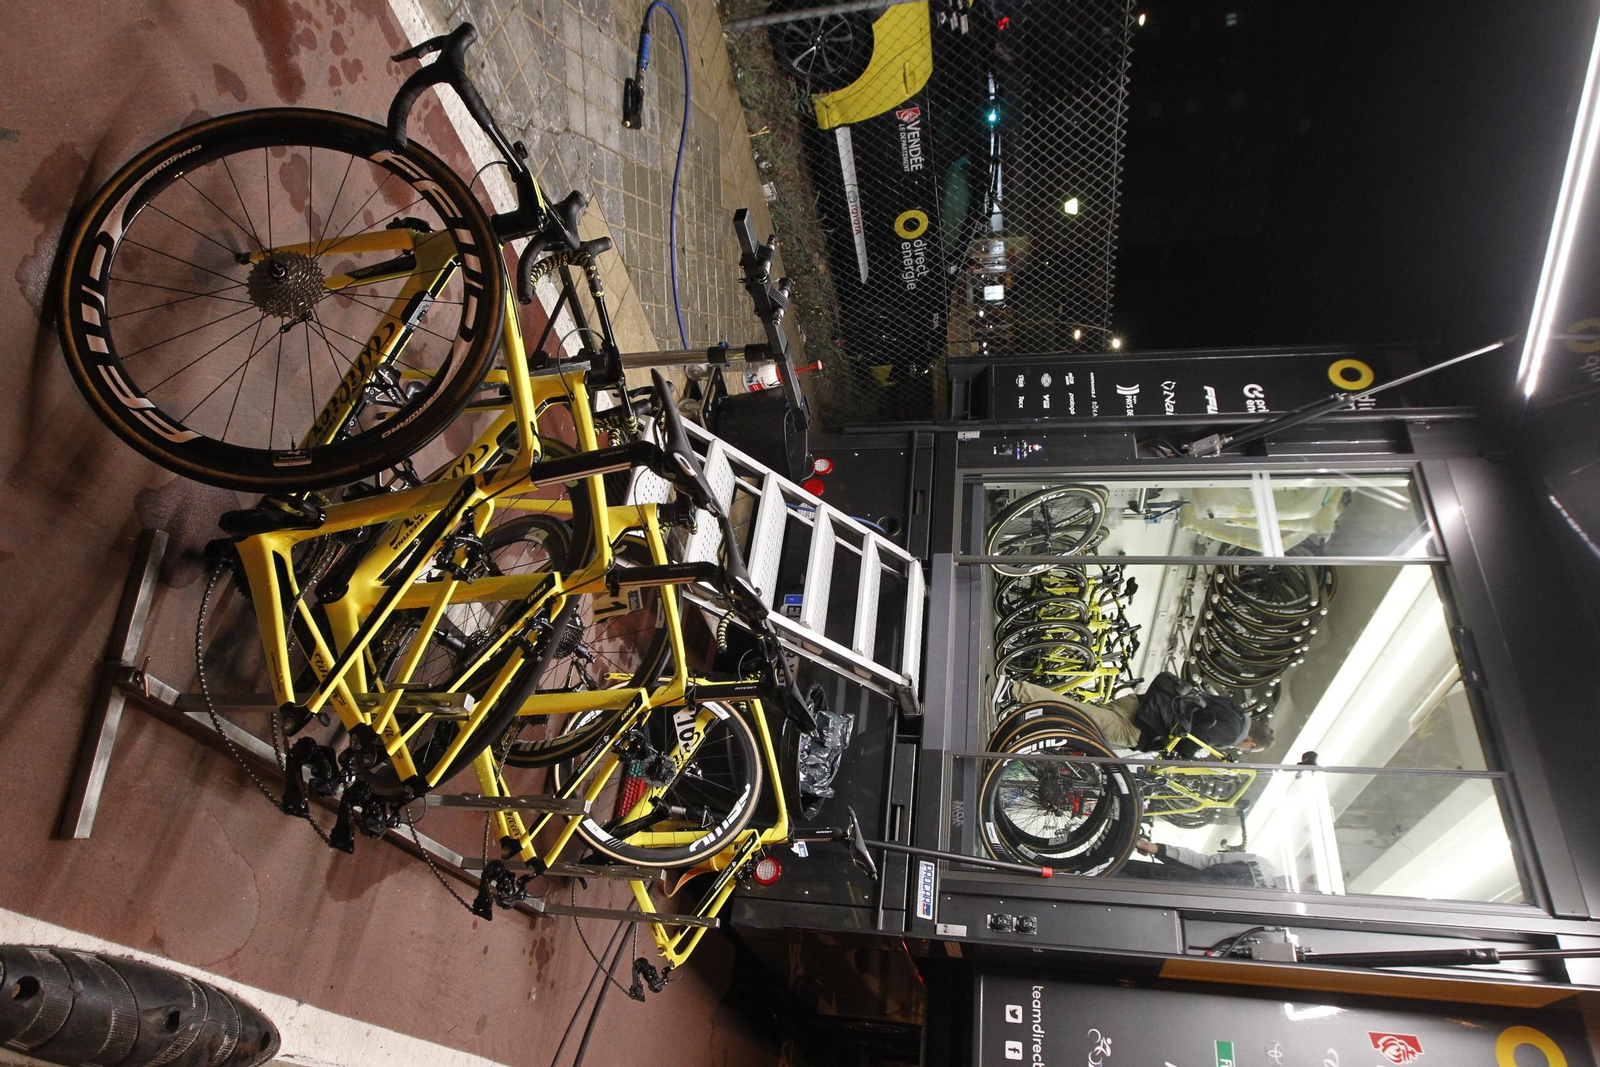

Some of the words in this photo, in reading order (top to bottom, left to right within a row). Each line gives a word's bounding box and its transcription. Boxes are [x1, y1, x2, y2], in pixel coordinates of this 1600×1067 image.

[850, 203, 862, 236] TOYOTA
[900, 242, 917, 290] energie
[912, 239, 929, 277] direct
[386, 388, 396, 401] Tacx
[392, 513, 428, 551] TRIESTINA
[922, 864, 933, 904] PROCAR
